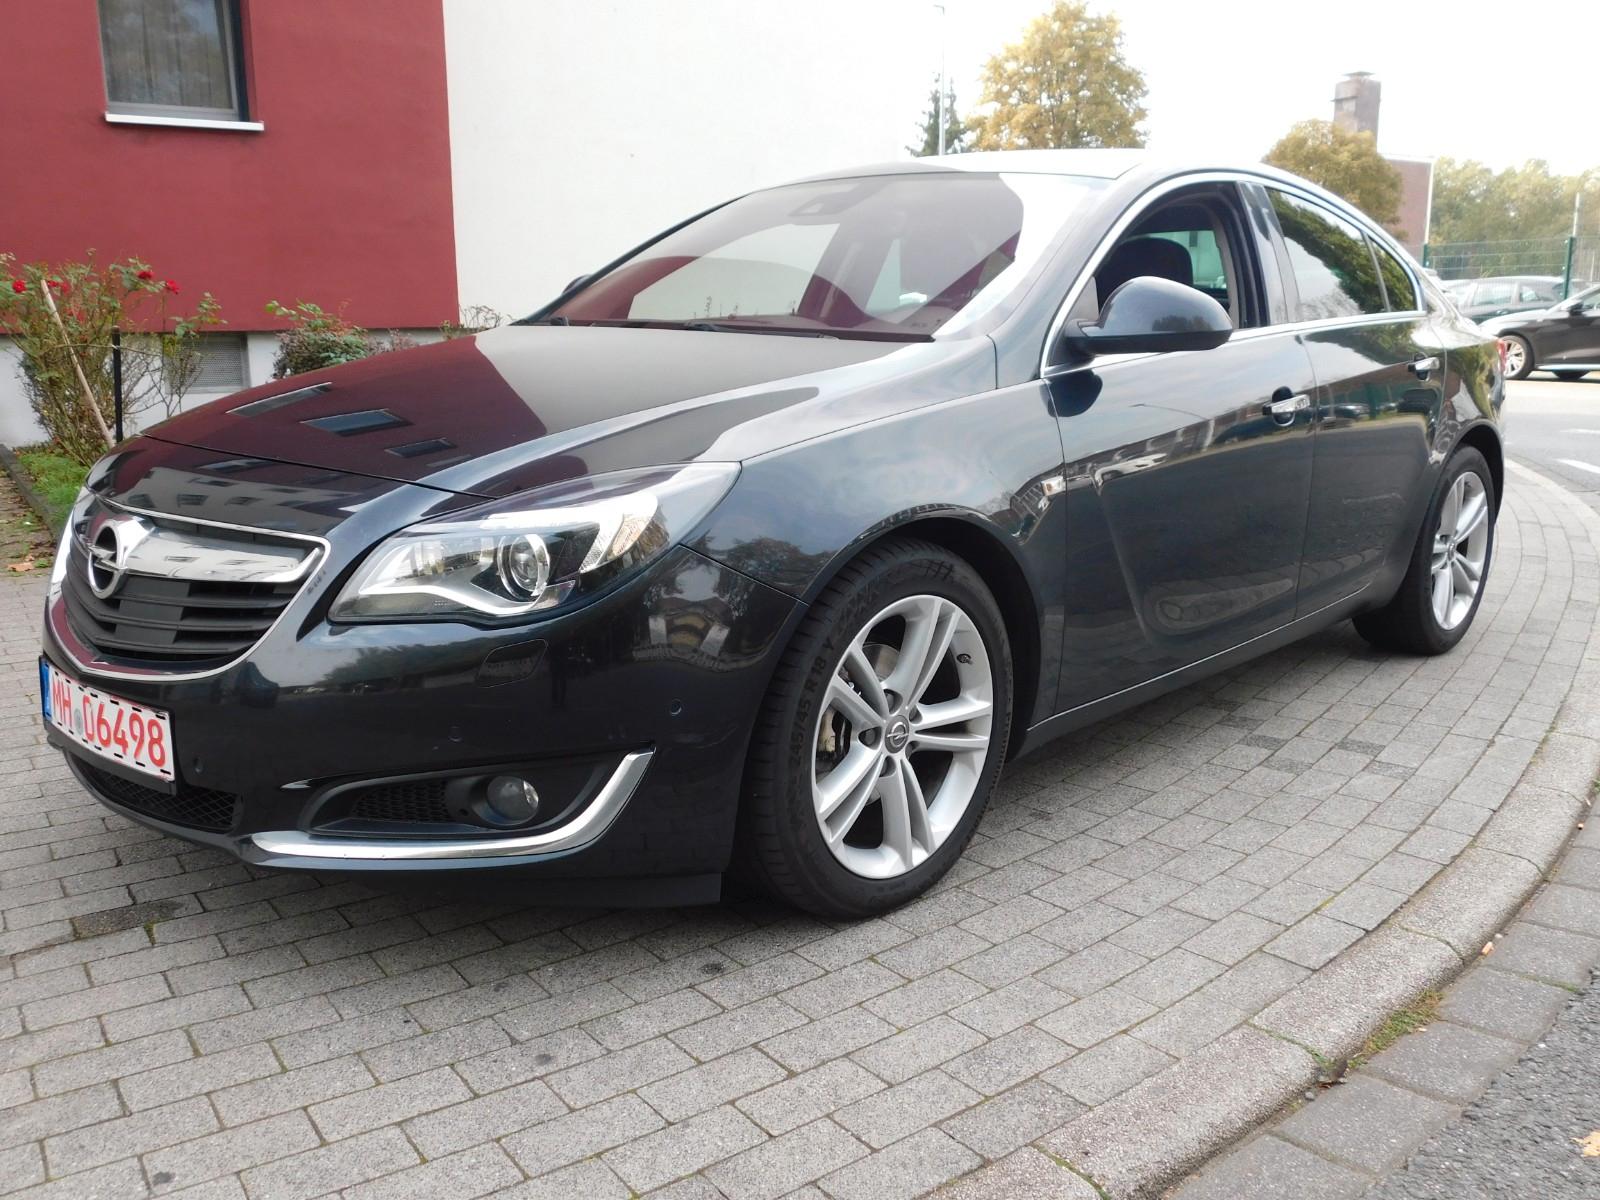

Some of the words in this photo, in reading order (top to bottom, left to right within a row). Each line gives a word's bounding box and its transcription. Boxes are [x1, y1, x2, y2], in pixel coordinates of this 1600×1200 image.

[803, 677, 819, 694] R
[810, 655, 827, 676] 18
[52, 676, 73, 729] MH
[82, 694, 166, 768] 06498
[787, 698, 812, 769] 245/45
